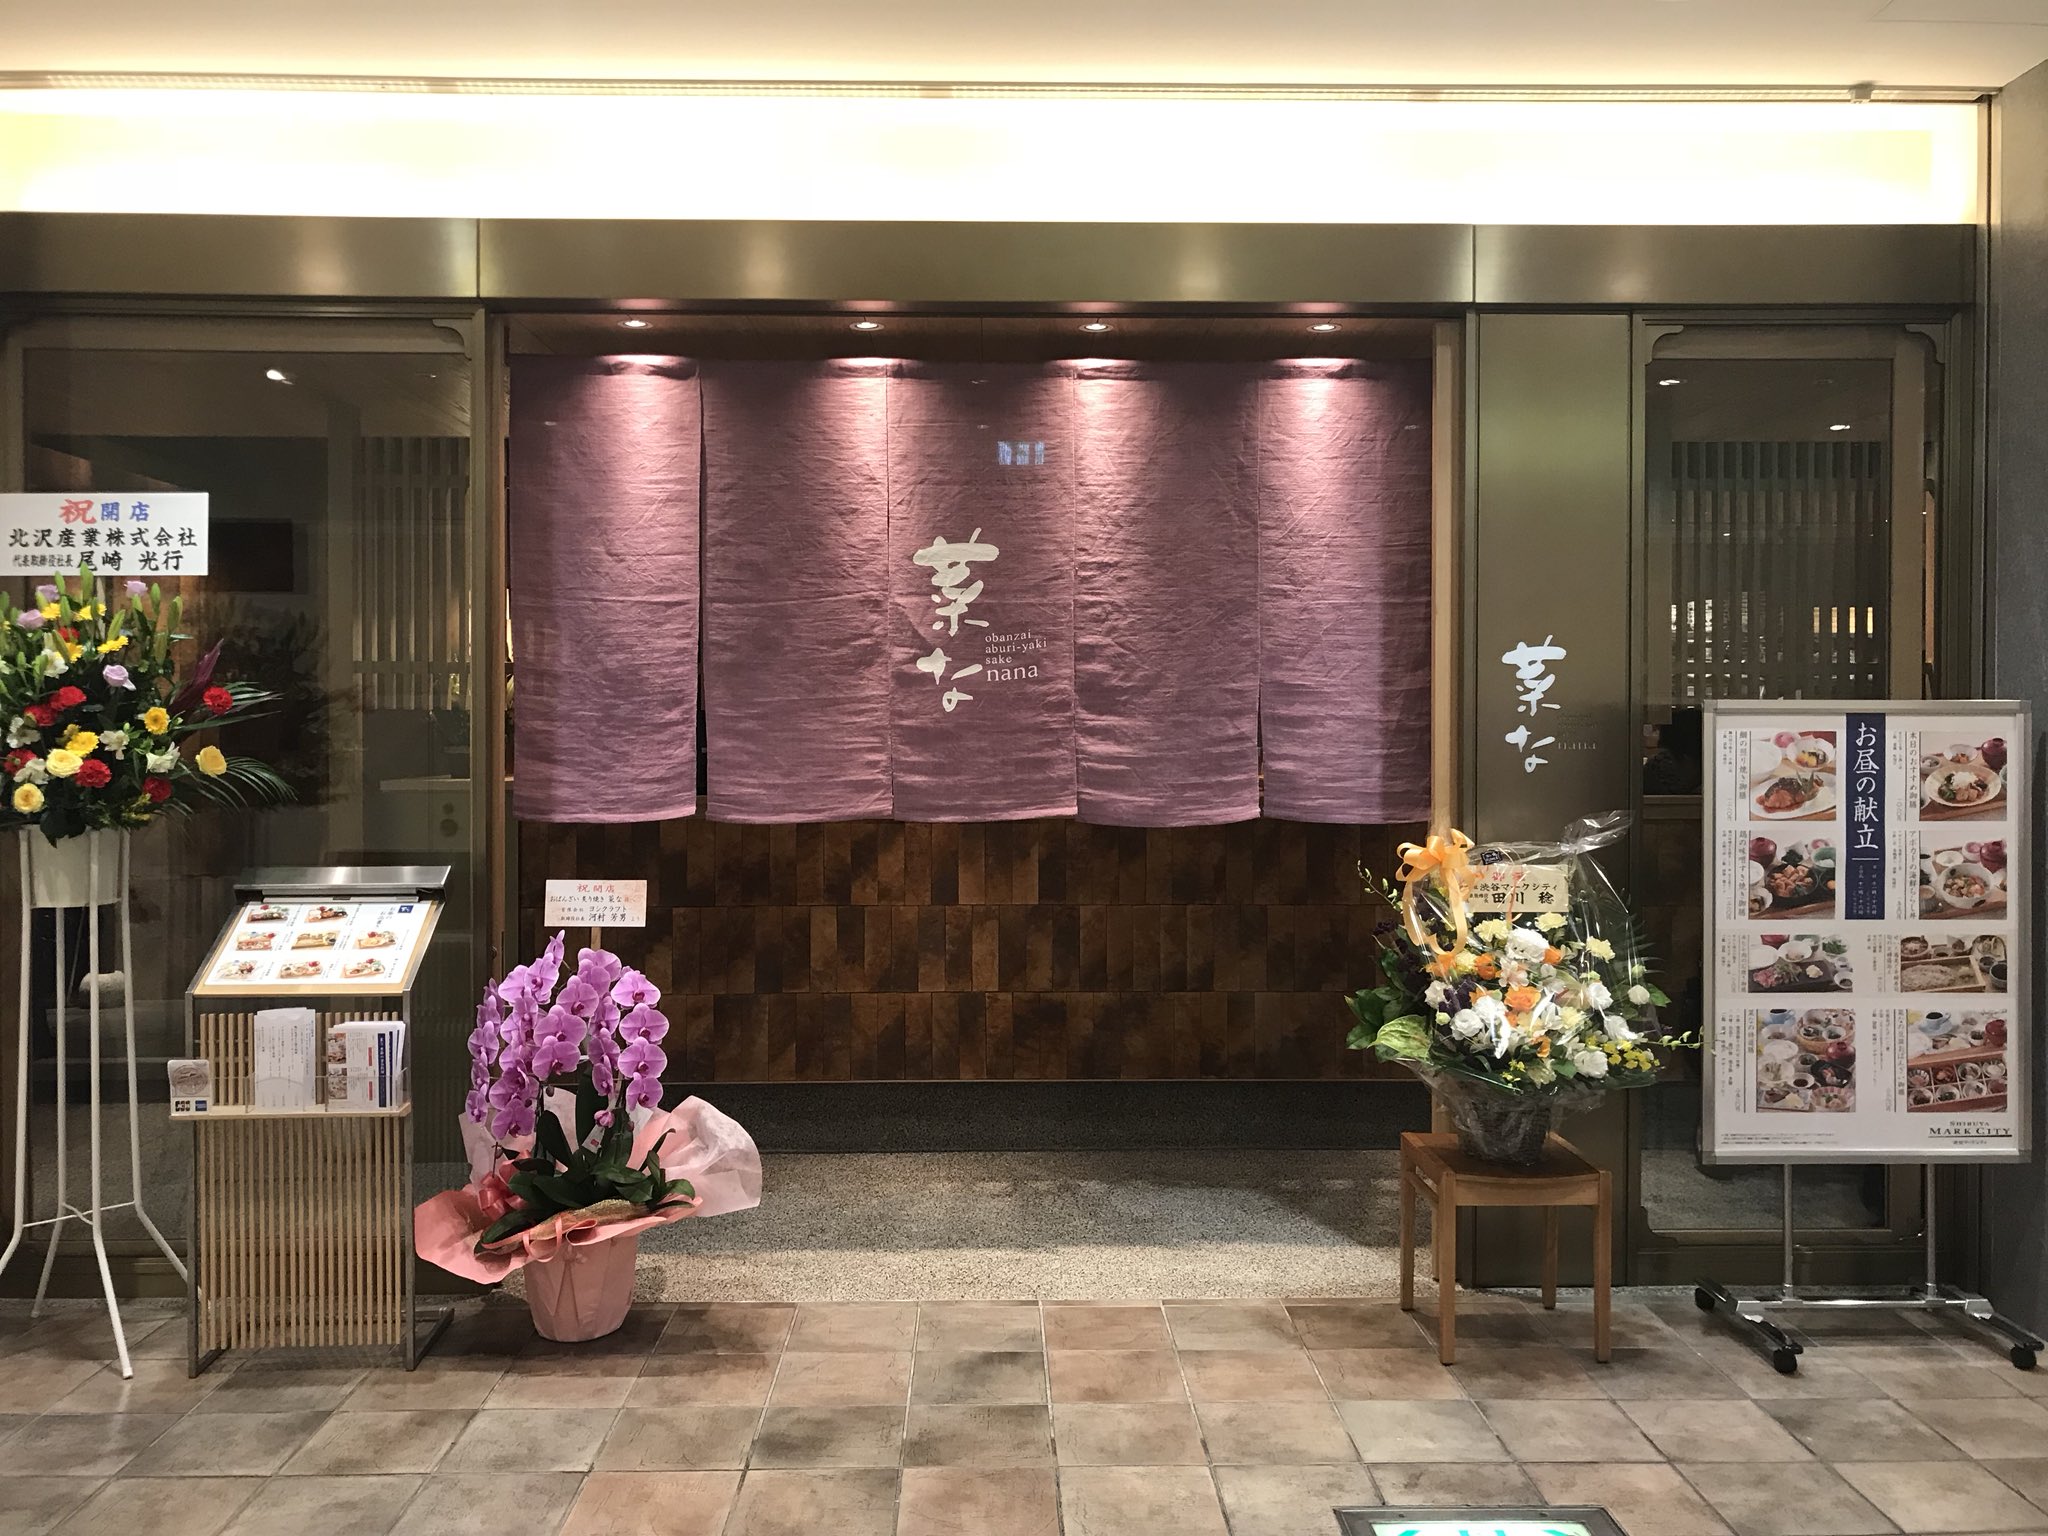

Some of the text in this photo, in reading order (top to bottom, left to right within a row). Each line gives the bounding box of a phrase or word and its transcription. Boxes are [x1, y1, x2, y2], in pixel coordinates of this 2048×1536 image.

[9, 527, 198, 548] 北沢産業株式会社
[139, 550, 184, 571] 光行
[985, 629, 1032, 643] obanzai
[985, 638, 1048, 654] aburi-yaki
[985, 654, 1012, 665] sake
[986, 664, 1039, 682] nana
[1853, 721, 1879, 850] お昼の献立
[1929, 1127, 2010, 1135] MARK CITY
